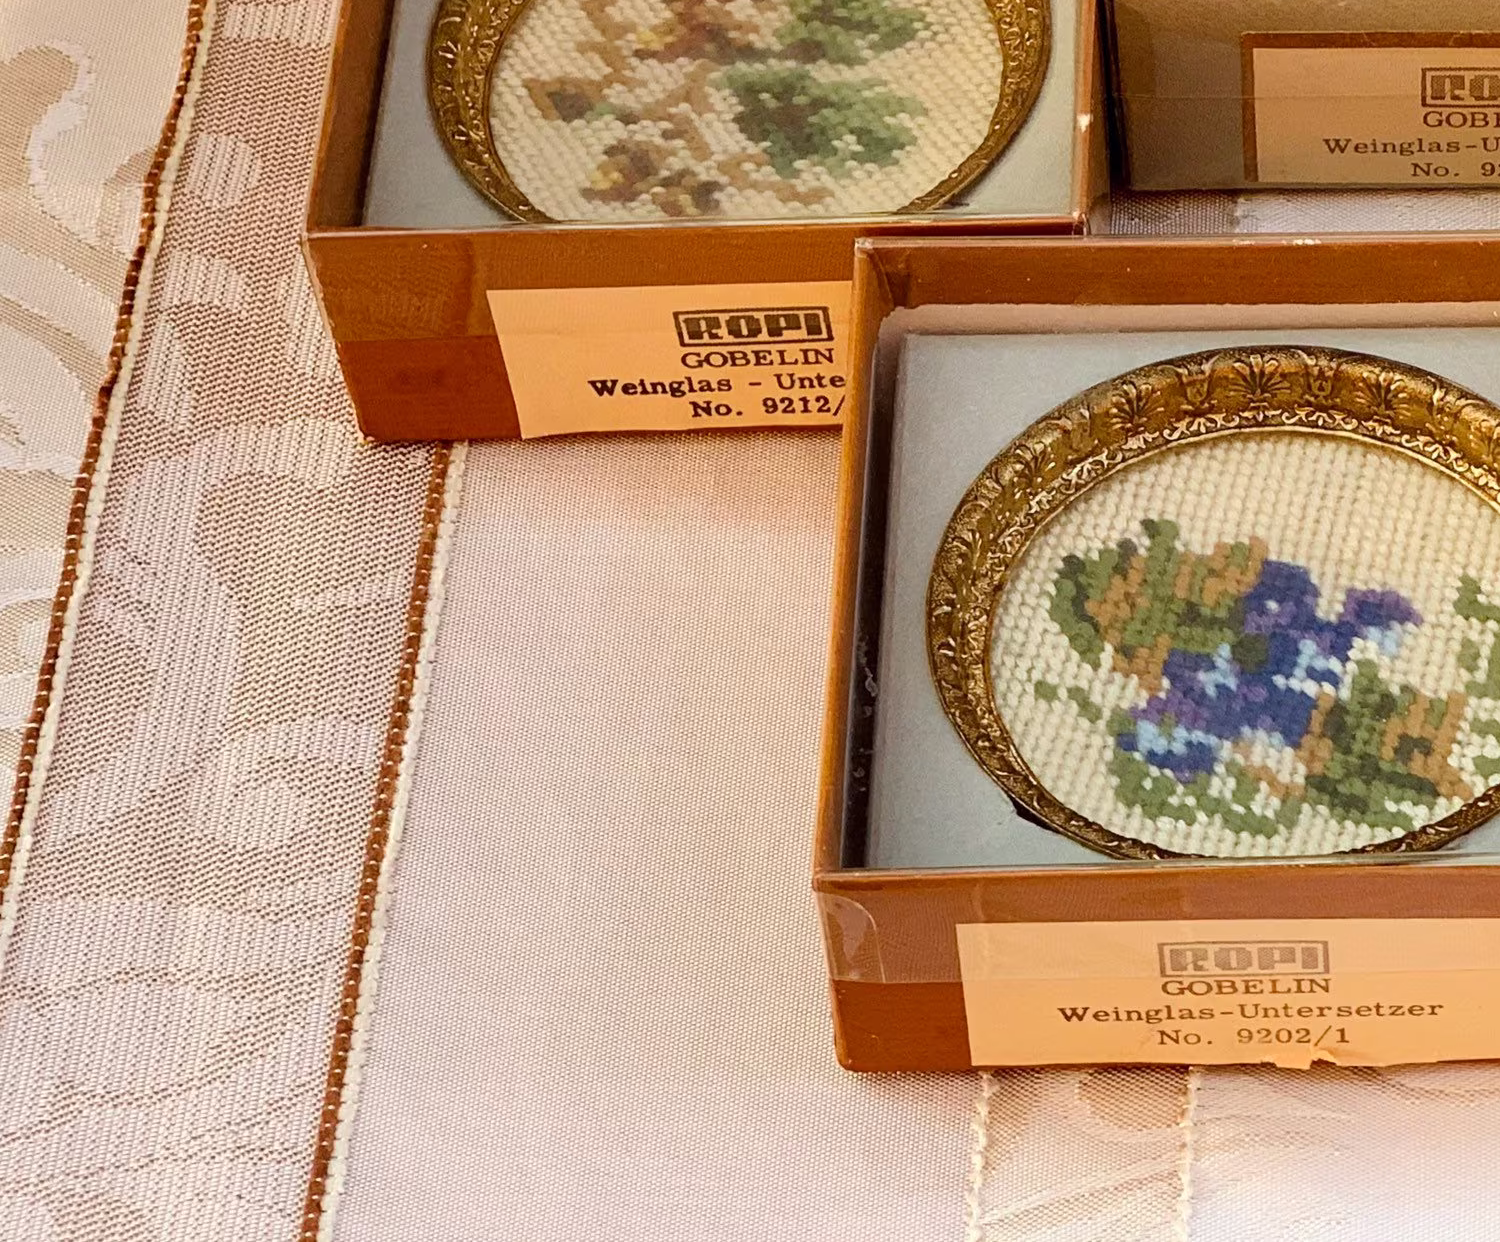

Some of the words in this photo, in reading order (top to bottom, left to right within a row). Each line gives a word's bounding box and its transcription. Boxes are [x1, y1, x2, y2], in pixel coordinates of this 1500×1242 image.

[1411, 162, 1459, 178] No.
[683, 312, 826, 341] ROPI
[680, 348, 834, 369] GOBELIN
[588, 376, 732, 398] Weinglas
[691, 400, 742, 418] No.
[1168, 945, 1324, 972] ROPI
[1161, 978, 1331, 996] GOBELIN
[1057, 1001, 1444, 1024] Weinglas-Untersetzer
[1157, 1028, 1213, 1046] No.
[1236, 1026, 1349, 1047] 9202/1
